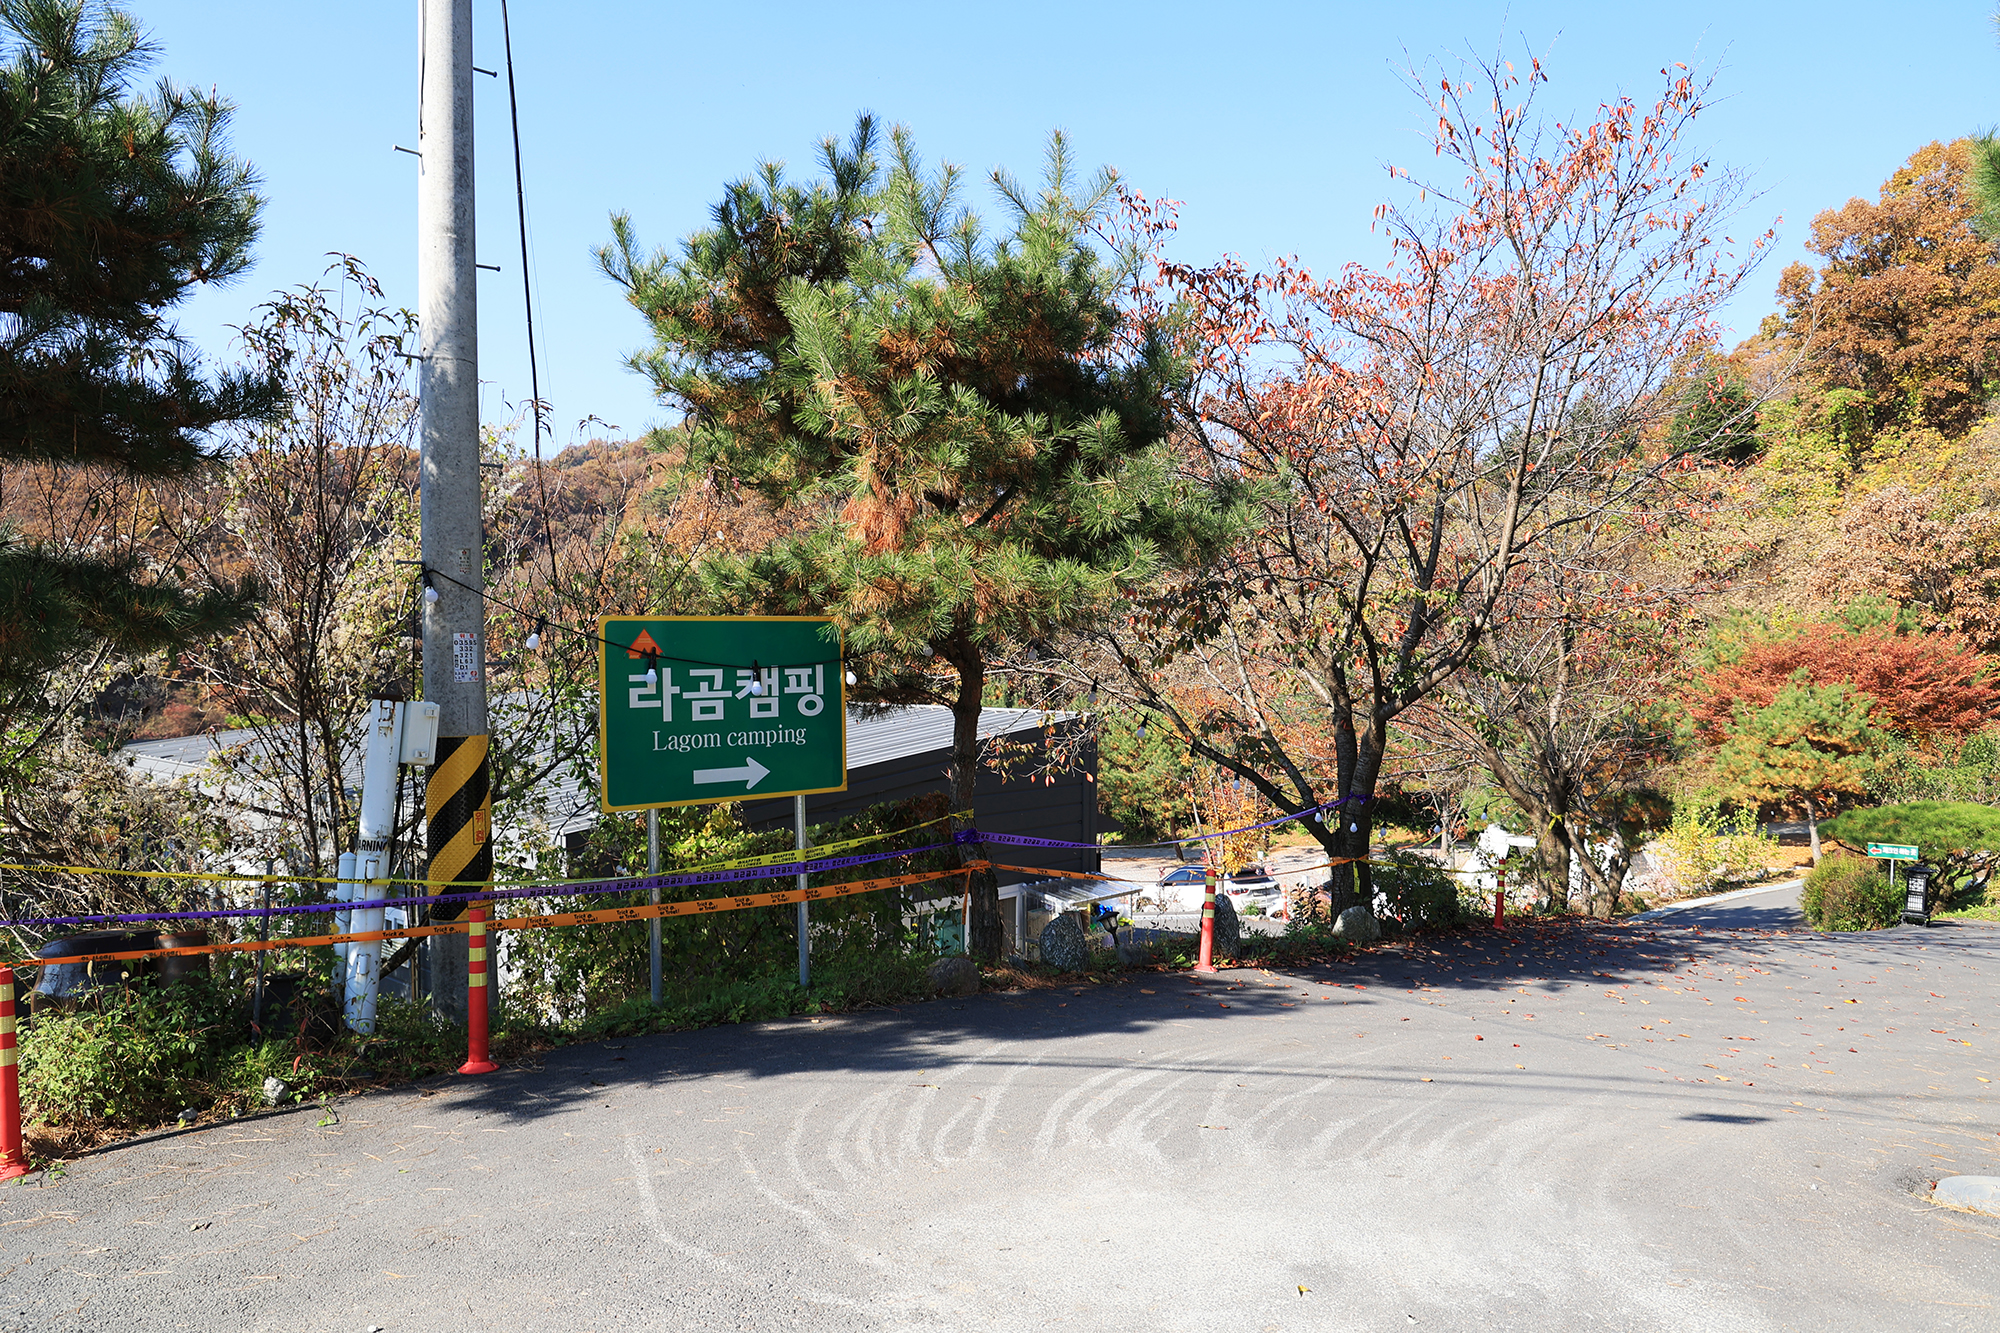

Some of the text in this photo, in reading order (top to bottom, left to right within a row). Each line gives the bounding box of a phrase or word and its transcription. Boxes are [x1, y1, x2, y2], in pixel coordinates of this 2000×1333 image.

[628, 664, 825, 722] 라곰캠핑
[652, 723, 807, 753] Lagom camping
[734, 870, 758, 878] 접근금지
[770, 866, 792, 875] 접근금지
[656, 878, 683, 886] 접근금지
[696, 874, 721, 882] 접근금지
[616, 881, 644, 890] 접근금지
